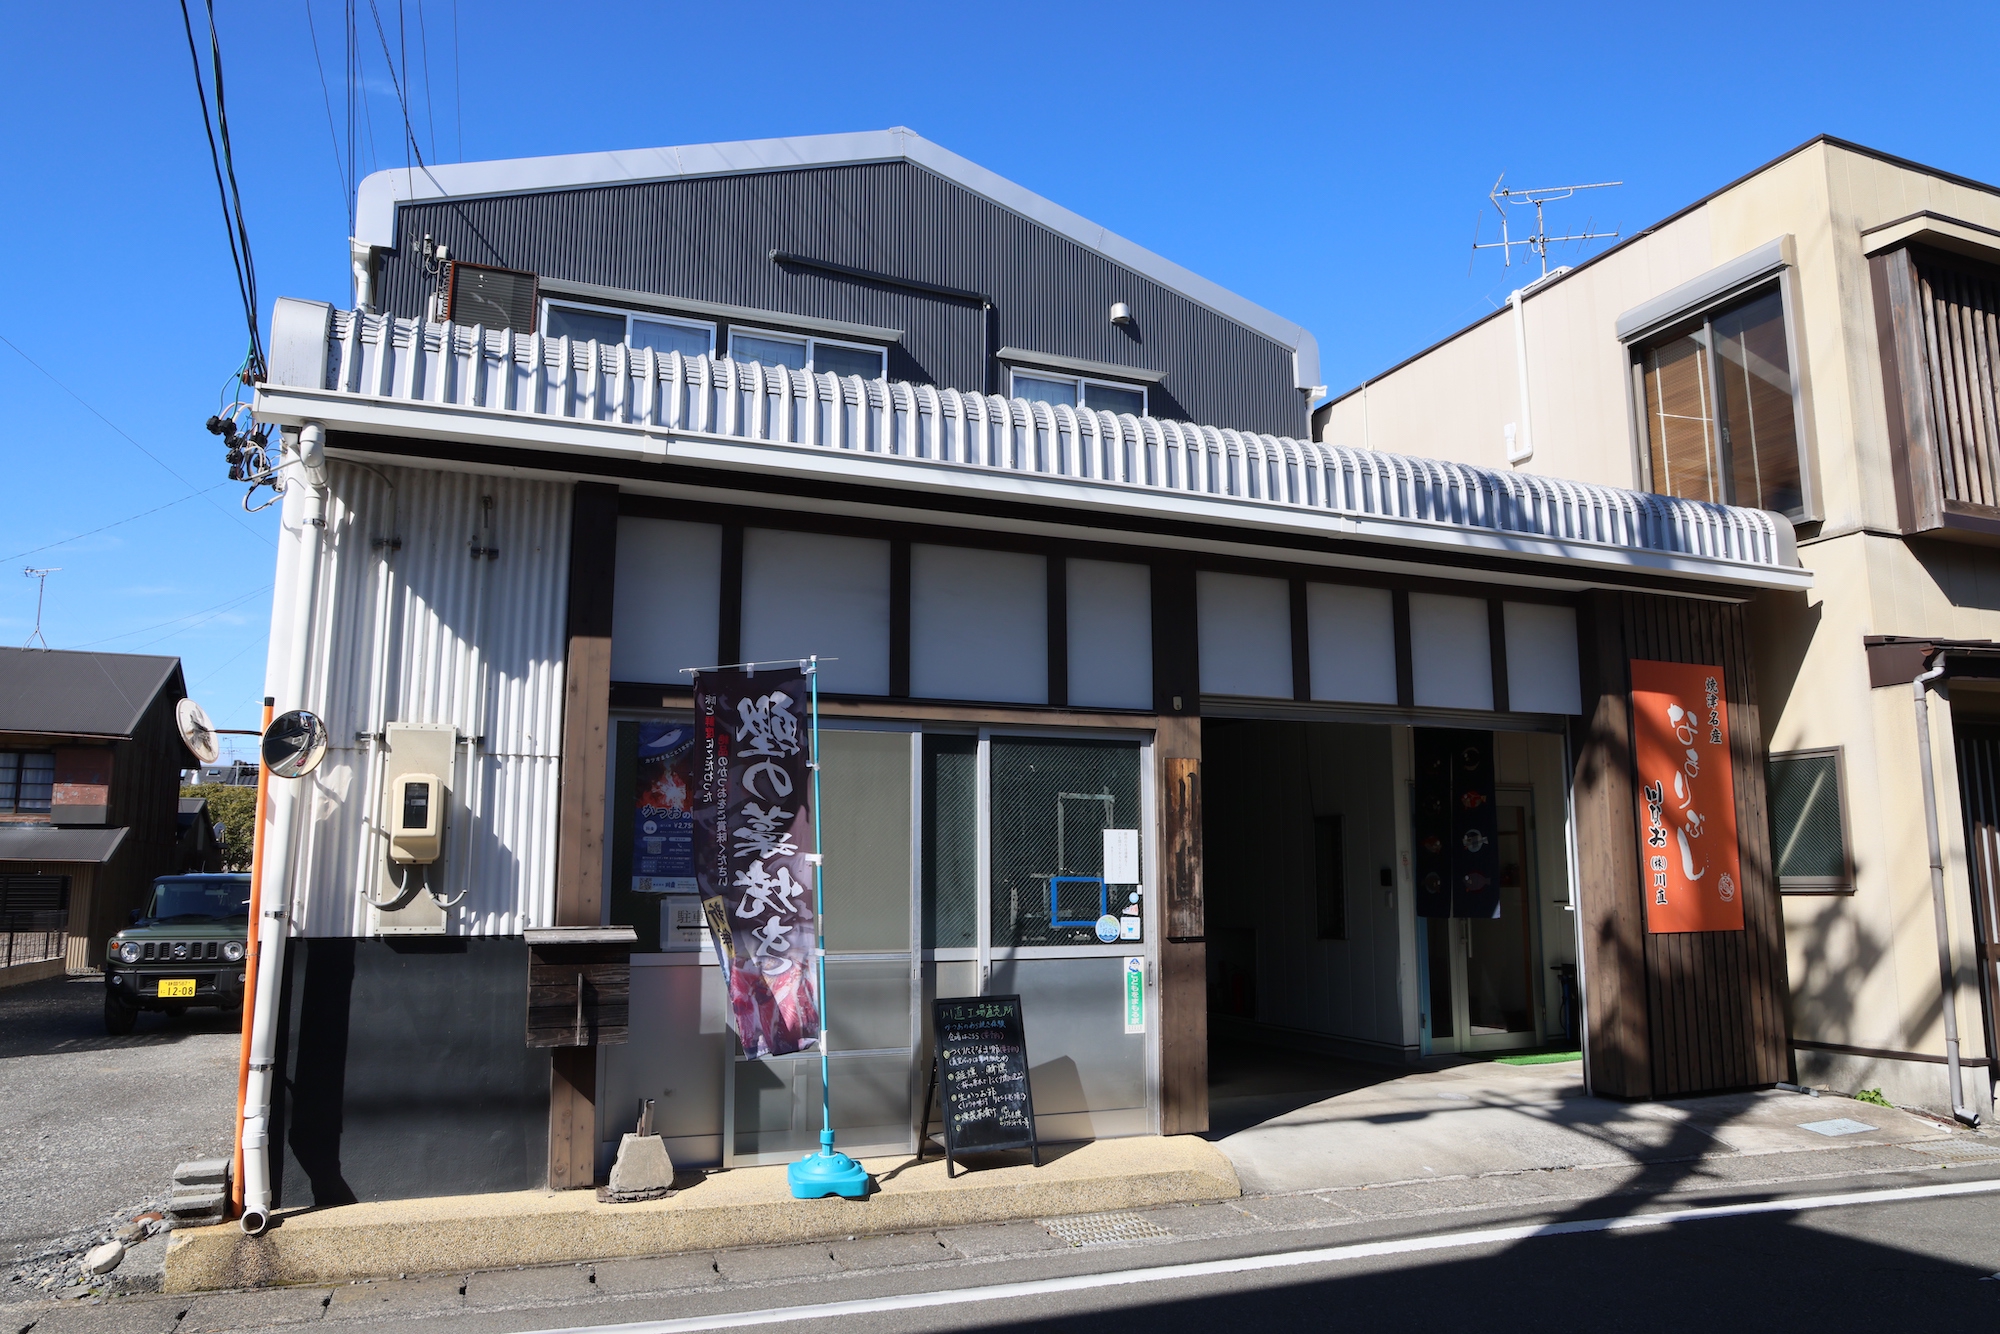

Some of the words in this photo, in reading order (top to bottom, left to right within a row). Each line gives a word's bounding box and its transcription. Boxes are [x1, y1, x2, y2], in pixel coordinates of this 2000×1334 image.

[1705, 677, 1723, 744] 焼津名産
[640, 804, 694, 820] かつおの
[1667, 703, 1706, 881] なまりぶし
[1650, 855, 1669, 905] (株)川直
[677, 910, 705, 923] 駐車
